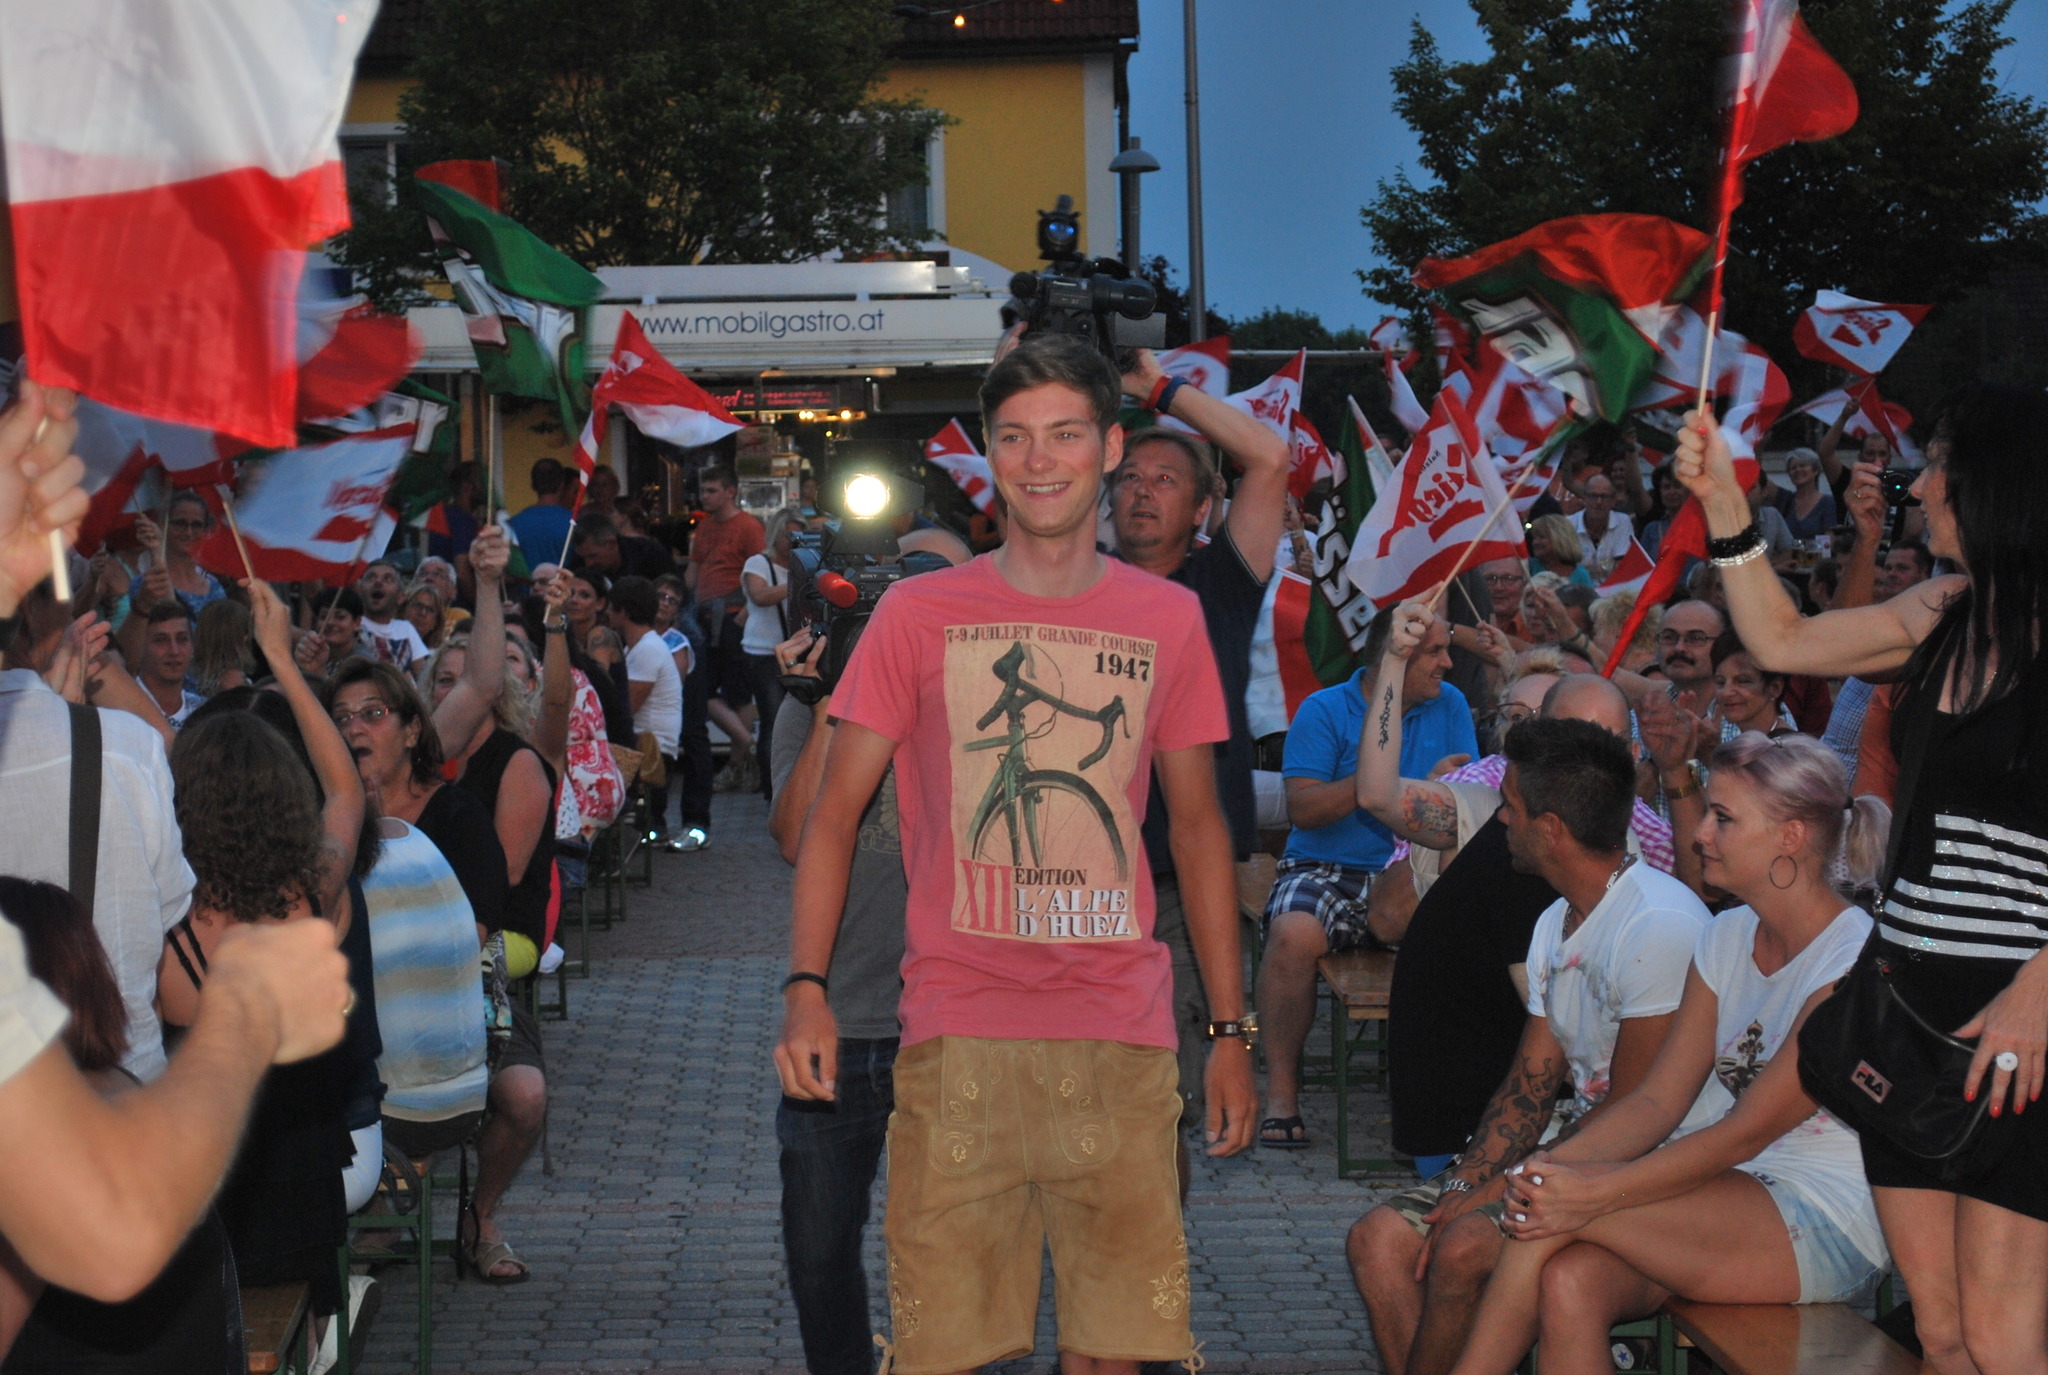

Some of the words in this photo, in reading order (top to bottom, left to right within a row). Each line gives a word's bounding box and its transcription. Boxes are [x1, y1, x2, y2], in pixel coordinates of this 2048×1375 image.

[946, 628, 967, 643] 7-9
[970, 625, 1032, 641] JUILLET
[1038, 627, 1096, 647] GRANDE
[1101, 634, 1155, 658] COURSE
[1094, 652, 1150, 681] 1947
[953, 859, 1013, 935] XII
[1856, 1066, 1884, 1098] FILA
